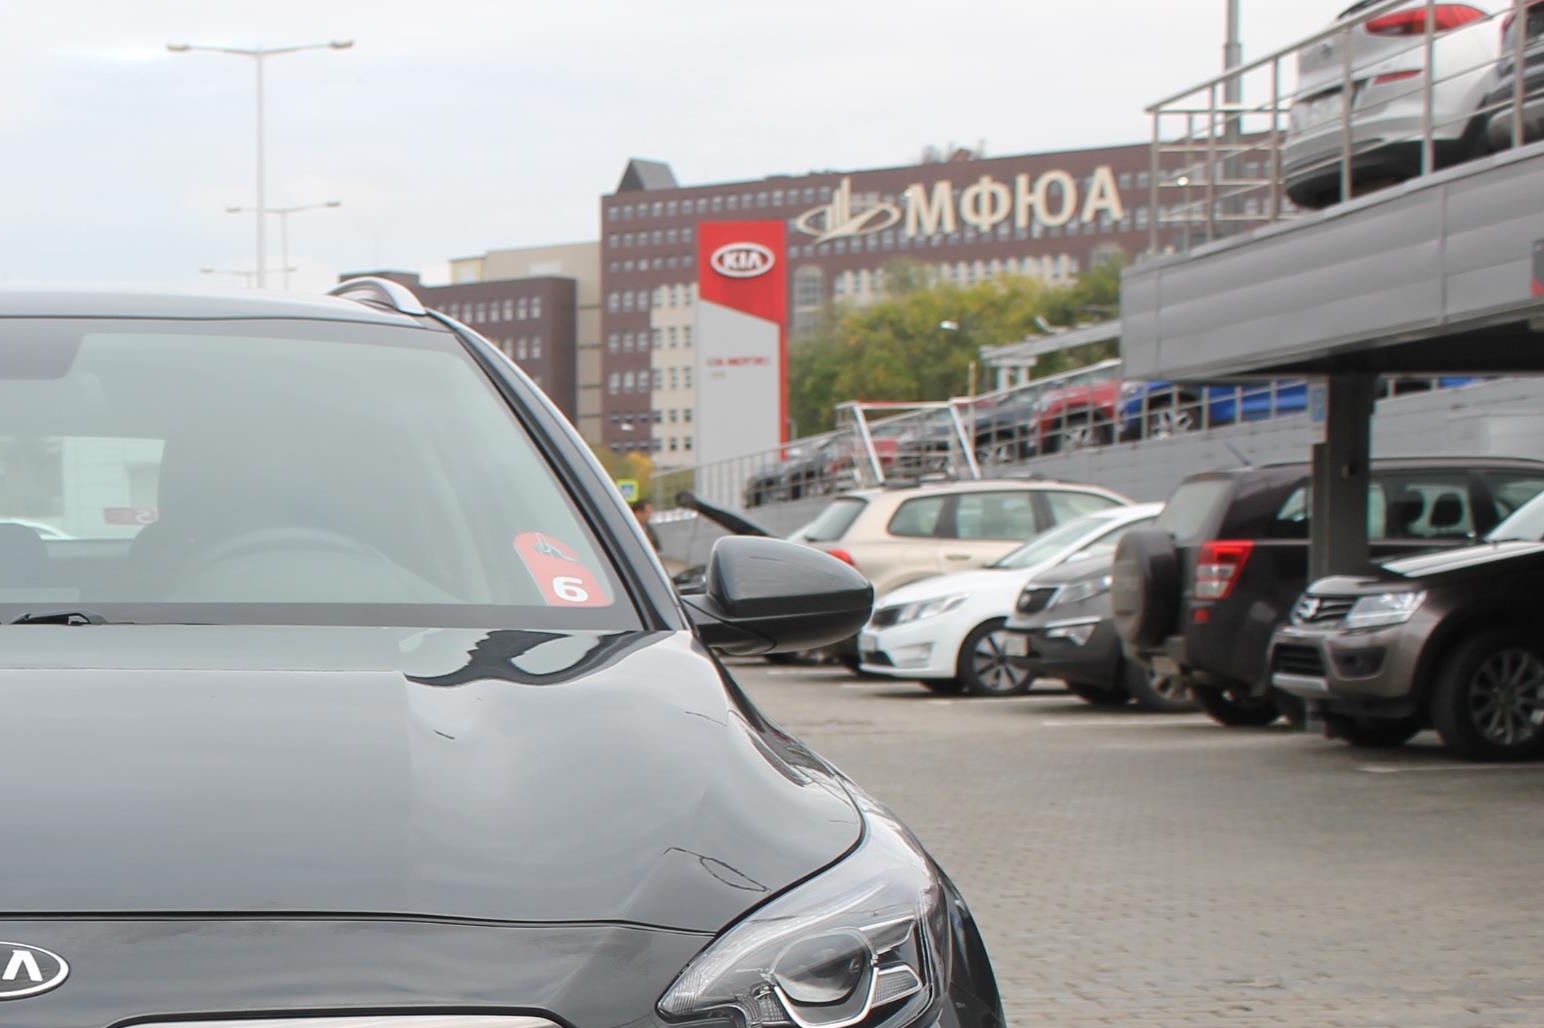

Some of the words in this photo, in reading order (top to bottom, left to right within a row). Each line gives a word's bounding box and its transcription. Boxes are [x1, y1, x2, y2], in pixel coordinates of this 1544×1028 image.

[905, 165, 1125, 238] МФЮА
[722, 250, 764, 270] KIA
[552, 576, 589, 602] 6
